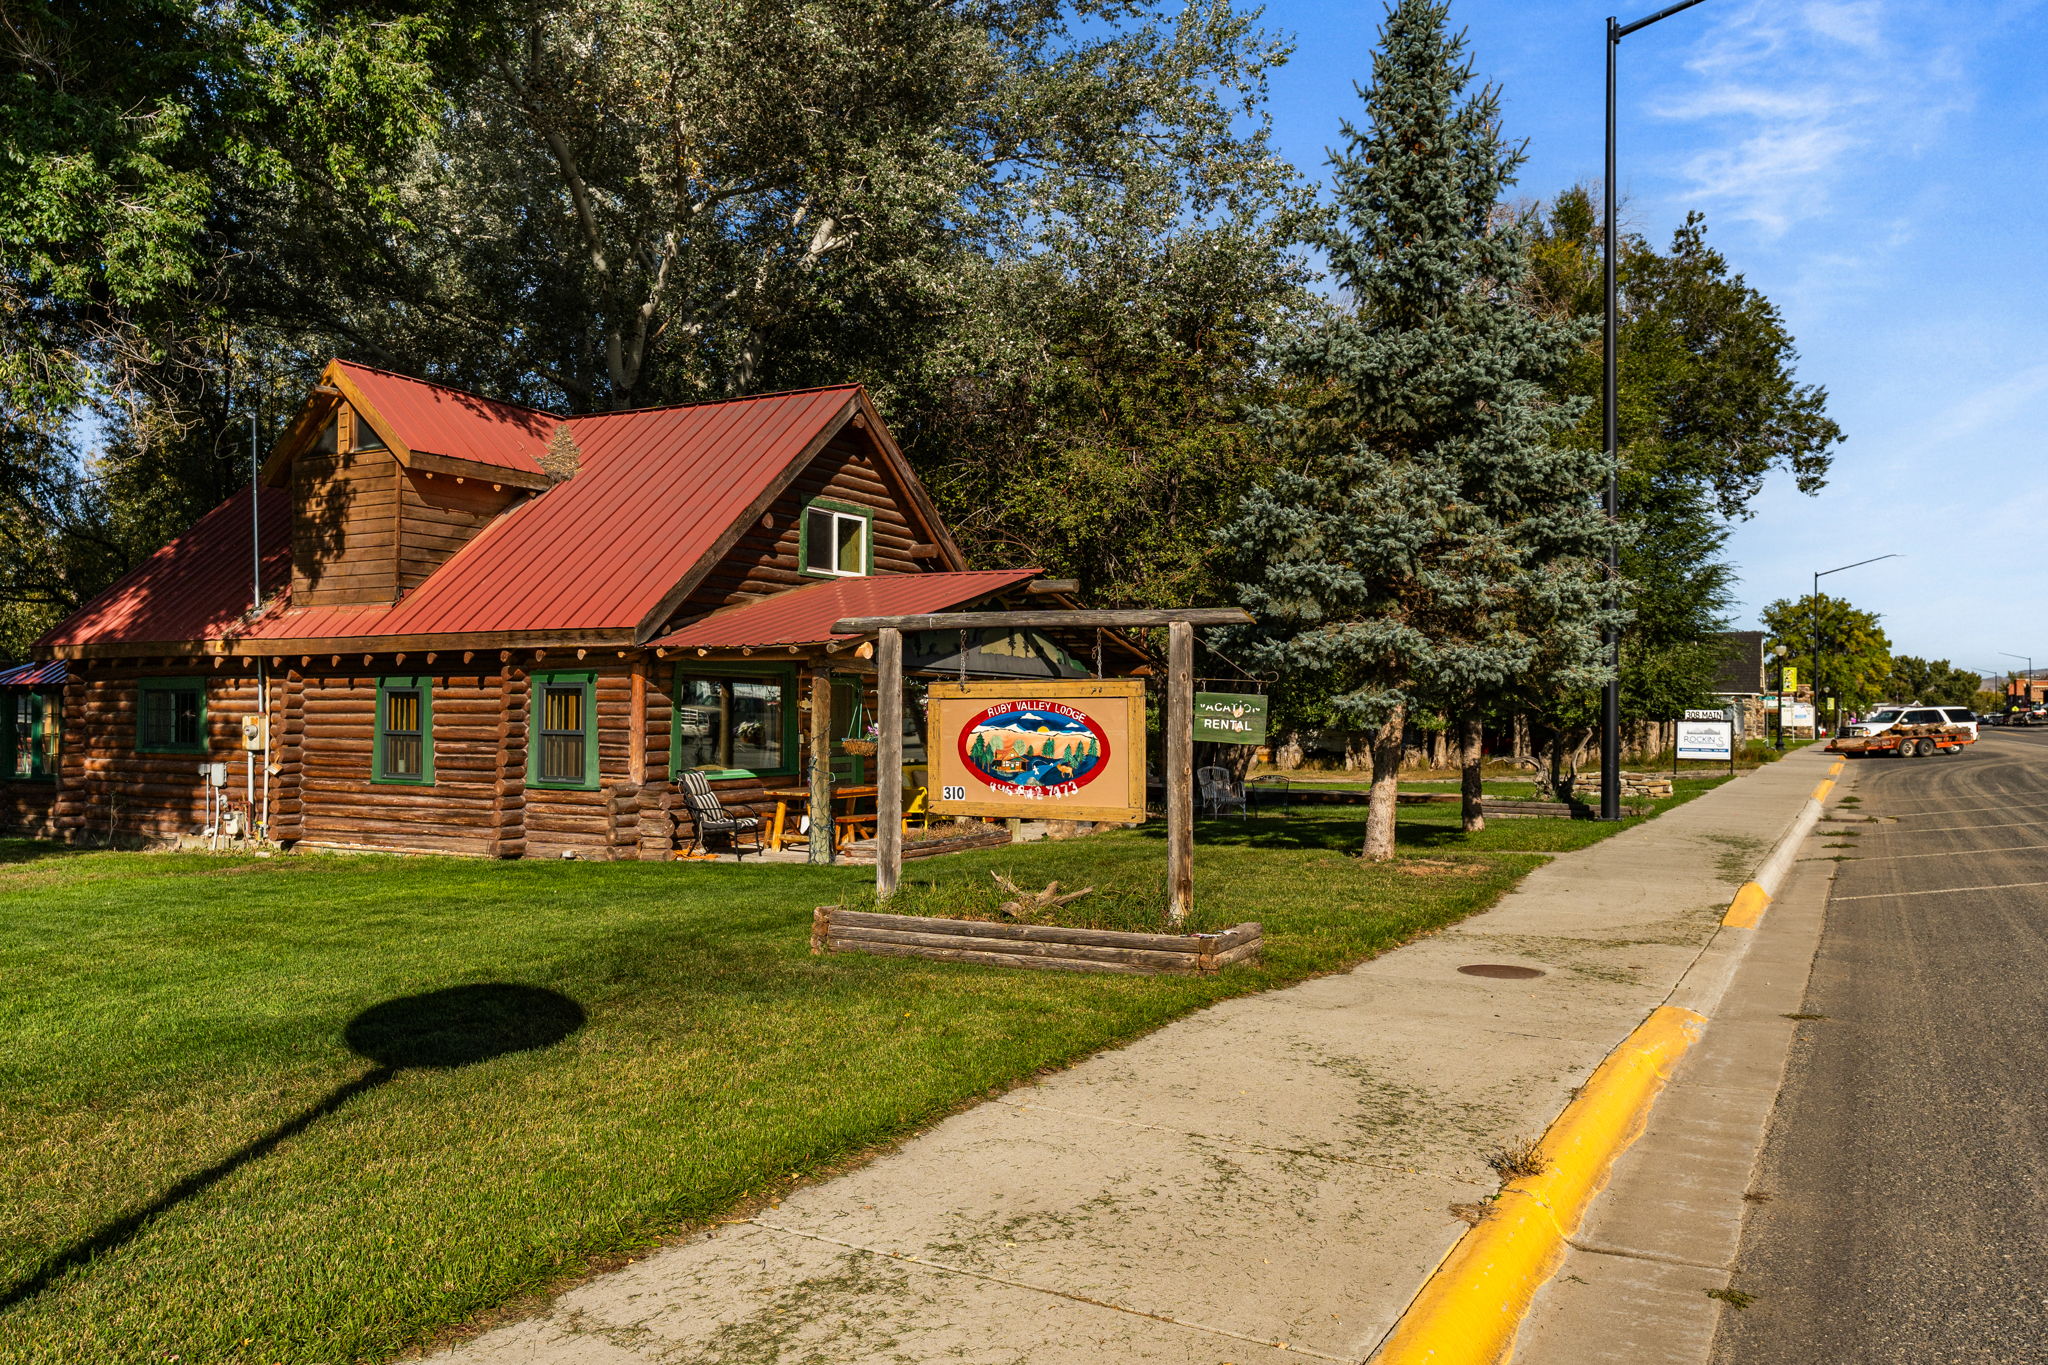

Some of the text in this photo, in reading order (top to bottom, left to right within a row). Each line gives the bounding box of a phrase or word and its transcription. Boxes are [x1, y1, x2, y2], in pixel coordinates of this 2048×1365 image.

[987, 701, 1087, 723] RUBY VALLEY LODGE
[1686, 711, 1722, 720] 308 MAIN
[1204, 718, 1253, 731] RENTAL
[943, 786, 965, 799] 310
